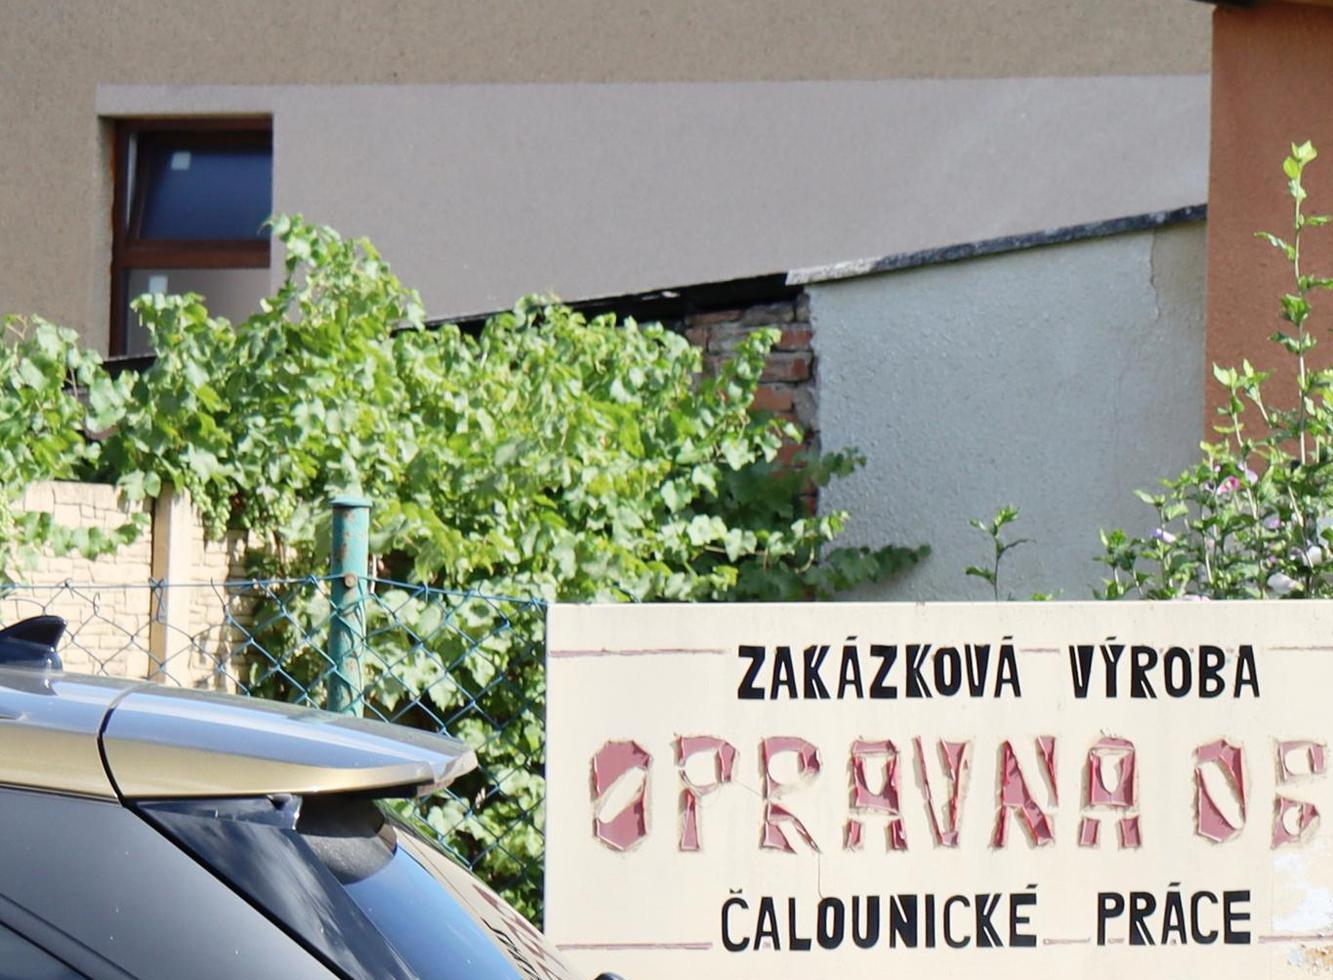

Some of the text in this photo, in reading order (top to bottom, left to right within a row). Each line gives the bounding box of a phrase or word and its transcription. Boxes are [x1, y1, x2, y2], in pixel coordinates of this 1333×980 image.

[738, 636, 1260, 699] ZAKÁZKOVÁ VÝROBA
[590, 733, 1143, 852] OPRAVNA
[721, 881, 1251, 952] ČALOUNICKÉ PRÁCE
